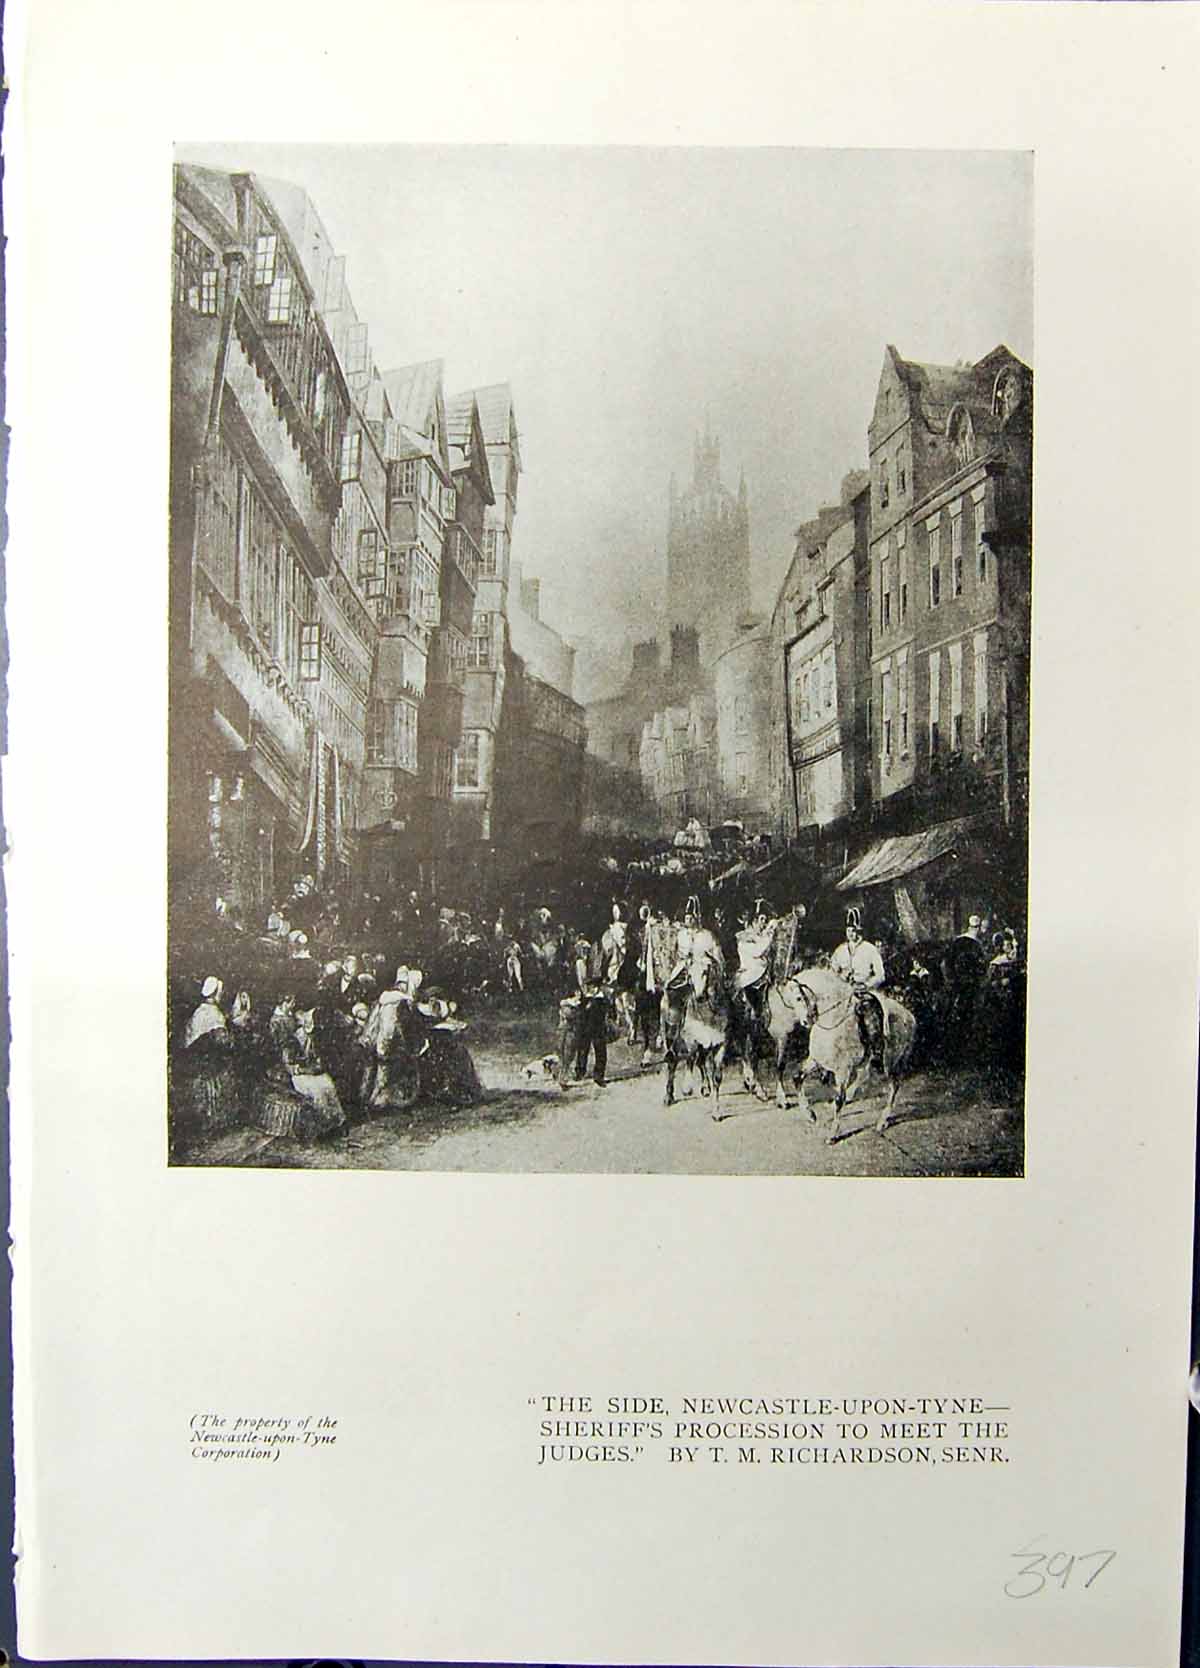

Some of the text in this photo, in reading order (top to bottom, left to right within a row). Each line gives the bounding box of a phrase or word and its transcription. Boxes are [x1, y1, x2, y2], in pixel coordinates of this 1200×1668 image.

[607, 1397, 670, 1416] SIDE,
[233, 1416, 291, 1431] property
[297, 1415, 313, 1430] of
[317, 1416, 338, 1429] the
[539, 1420, 1009, 1439] SHERIFF'S PROCESSION TO MEET THE
[190, 1430, 337, 1447] Newcastle-upon-Tyne
[191, 1447, 281, 1462] Corporation)
[668, 1447, 699, 1463] BY
[708, 1447, 728, 1463] T.
[738, 1447, 761, 1463] M.
[770, 1446, 936, 1466] RICHARDSON,
[940, 1446, 1010, 1463] SENR.
[1004, 1549, 1117, 1599] 397
